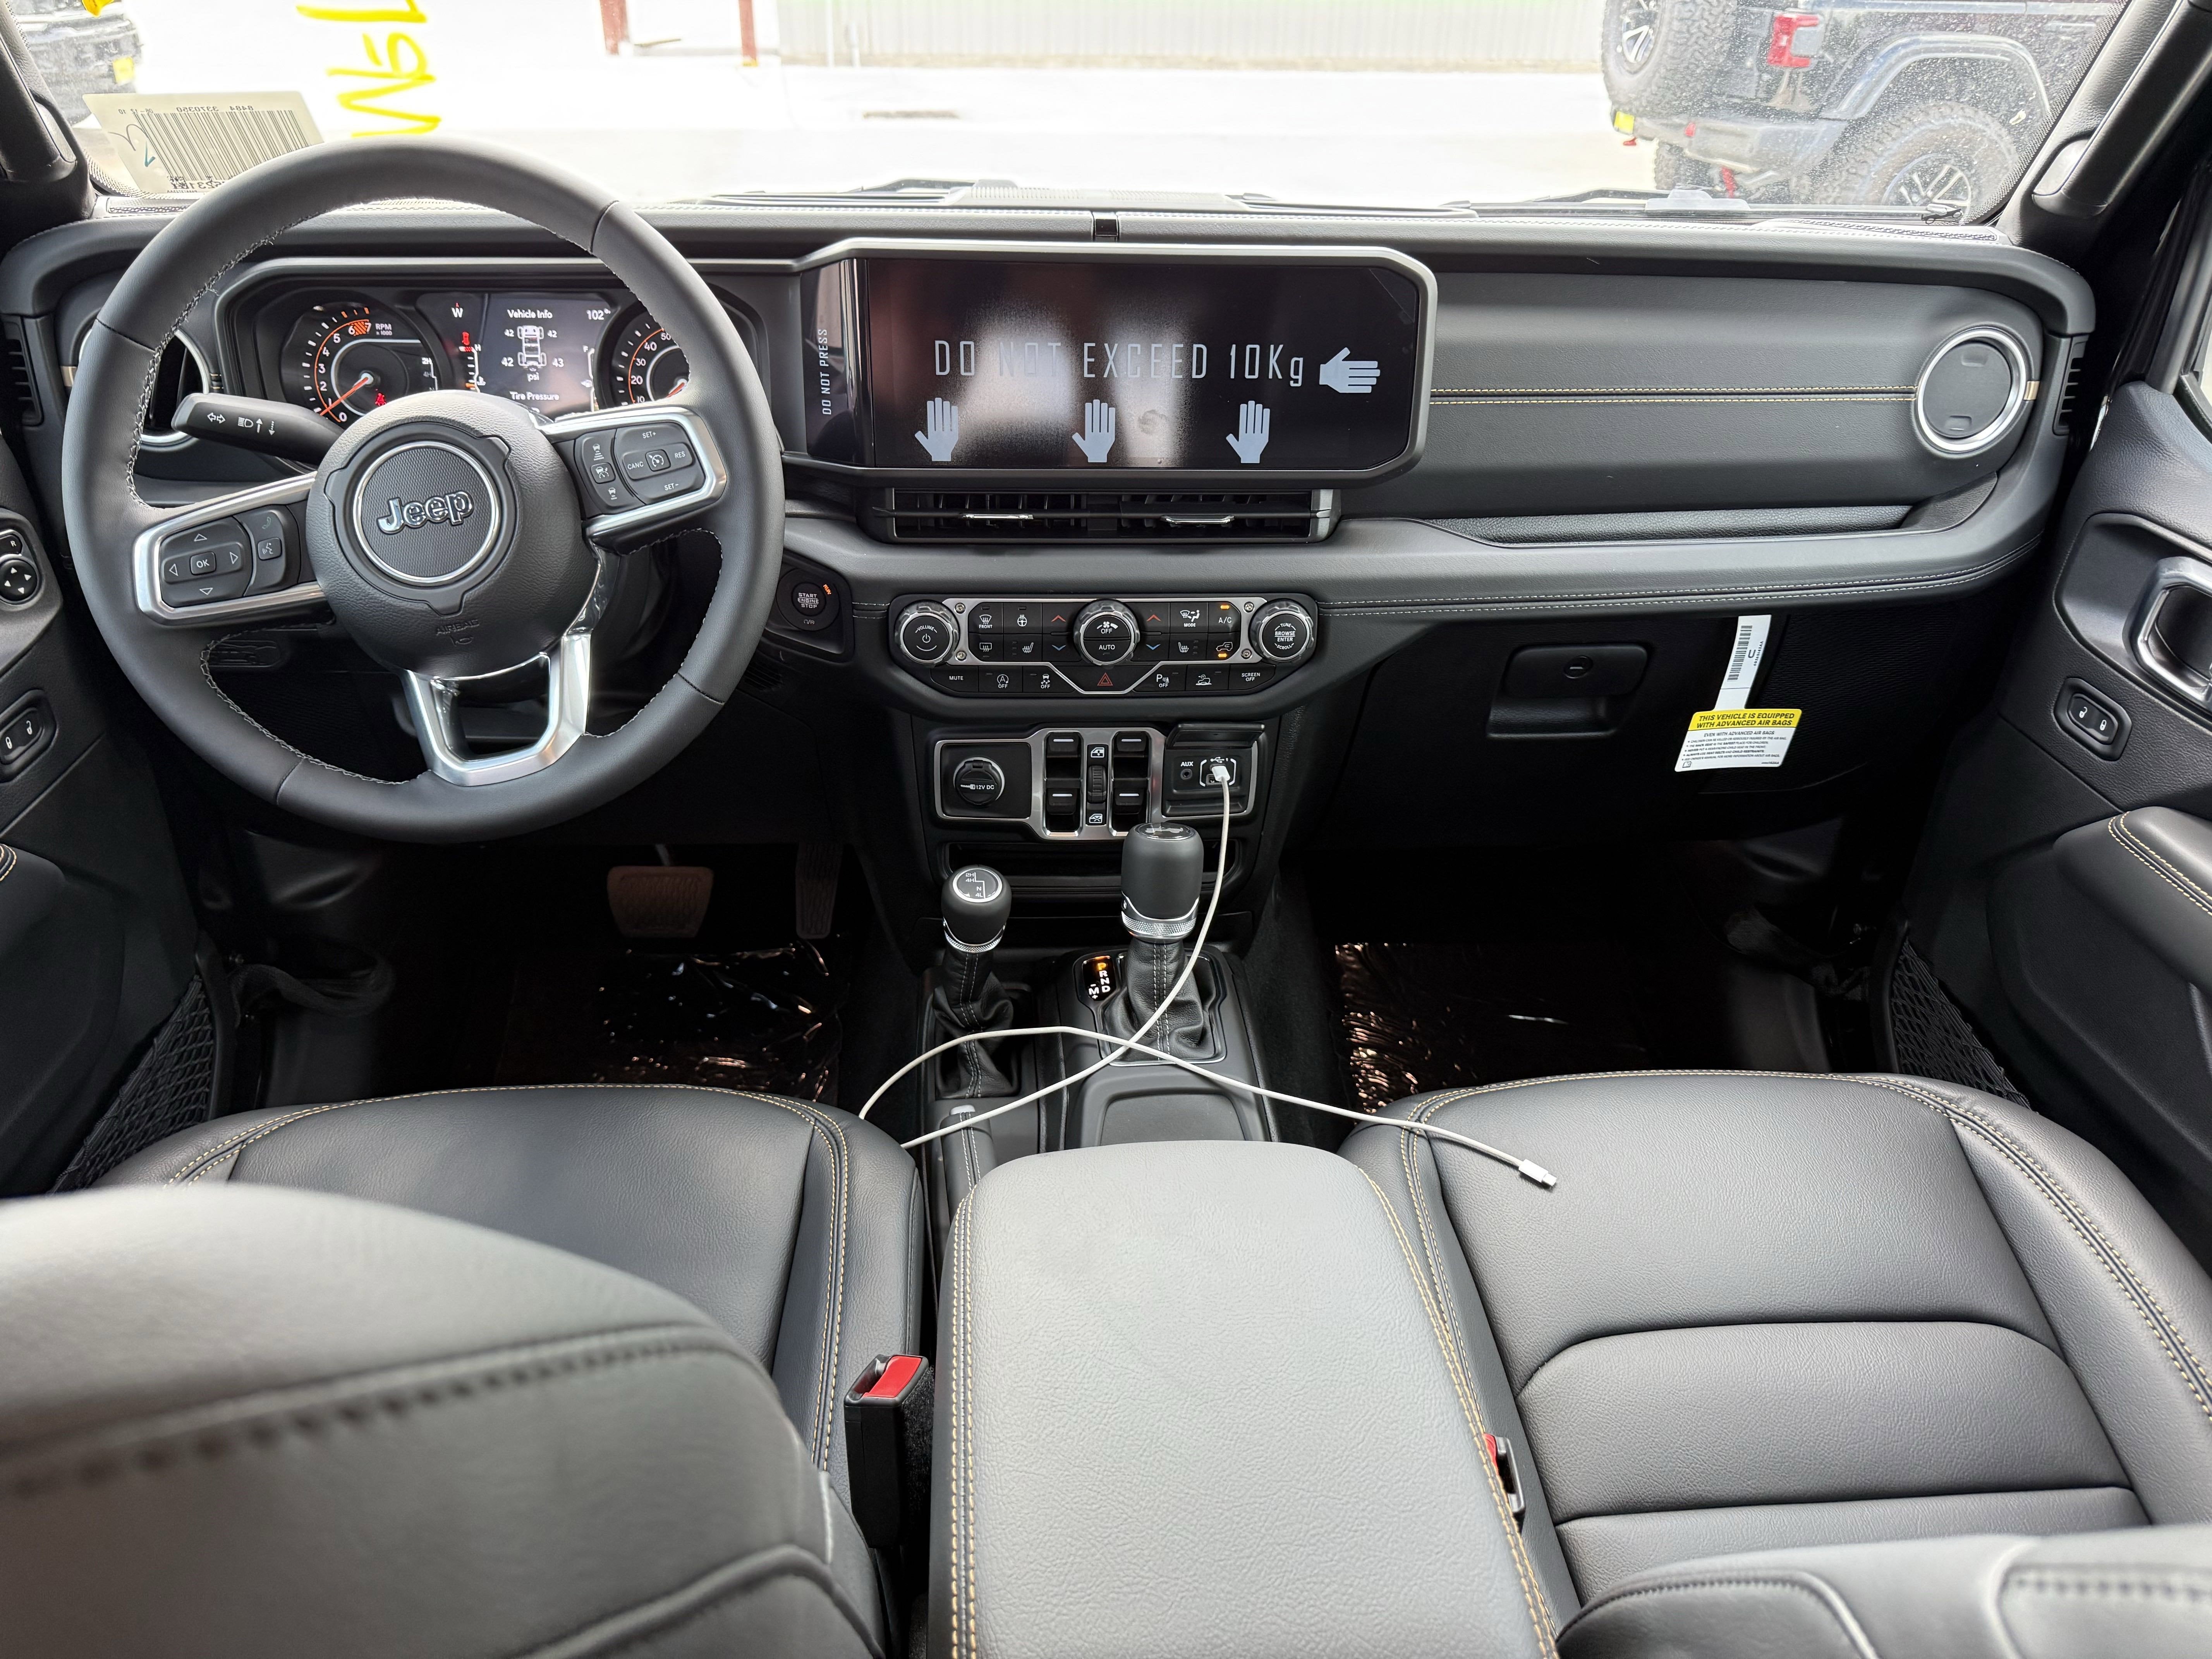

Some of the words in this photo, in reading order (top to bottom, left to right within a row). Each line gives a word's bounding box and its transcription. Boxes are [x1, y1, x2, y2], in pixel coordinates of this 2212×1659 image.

[451, 307, 464, 318] W
[507, 309, 536, 319] Vehicle
[537, 309, 553, 319] Info
[364, 323, 372, 332] 7
[333, 333, 341, 343] 5
[504, 329, 515, 337] 42
[661, 332, 671, 340] 50
[474, 343, 481, 352] H
[644, 341, 657, 351] 40
[818, 329, 829, 367] PRESS
[323, 347, 330, 357] 4
[501, 357, 515, 367] 42
[551, 357, 564, 368] 43
[635, 358, 646, 366] 30
[935, 340, 975, 376] DO
[999, 342, 1061, 376] NOT
[1084, 342, 1207, 379] EXCEED
[1230, 343, 1304, 387] 10Kg
[318, 363, 326, 374] 3
[527, 372, 540, 382] psi
[631, 375, 643, 385] 20
[320, 381, 327, 391] 2
[820, 372, 831, 394] NOT
[510, 391, 526, 400] Tire
[527, 392, 560, 401] Pressure
[822, 399, 832, 415] DO
[339, 412, 347, 422] 0
[627, 461, 644, 470] CANC
[377, 490, 474, 534] Jeep
[196, 559, 210, 569] OK
[823, 584, 832, 595] RUN
[436, 620, 480, 635] AIRBAG
[1097, 962, 1106, 971] P
[1089, 987, 1099, 995] M
